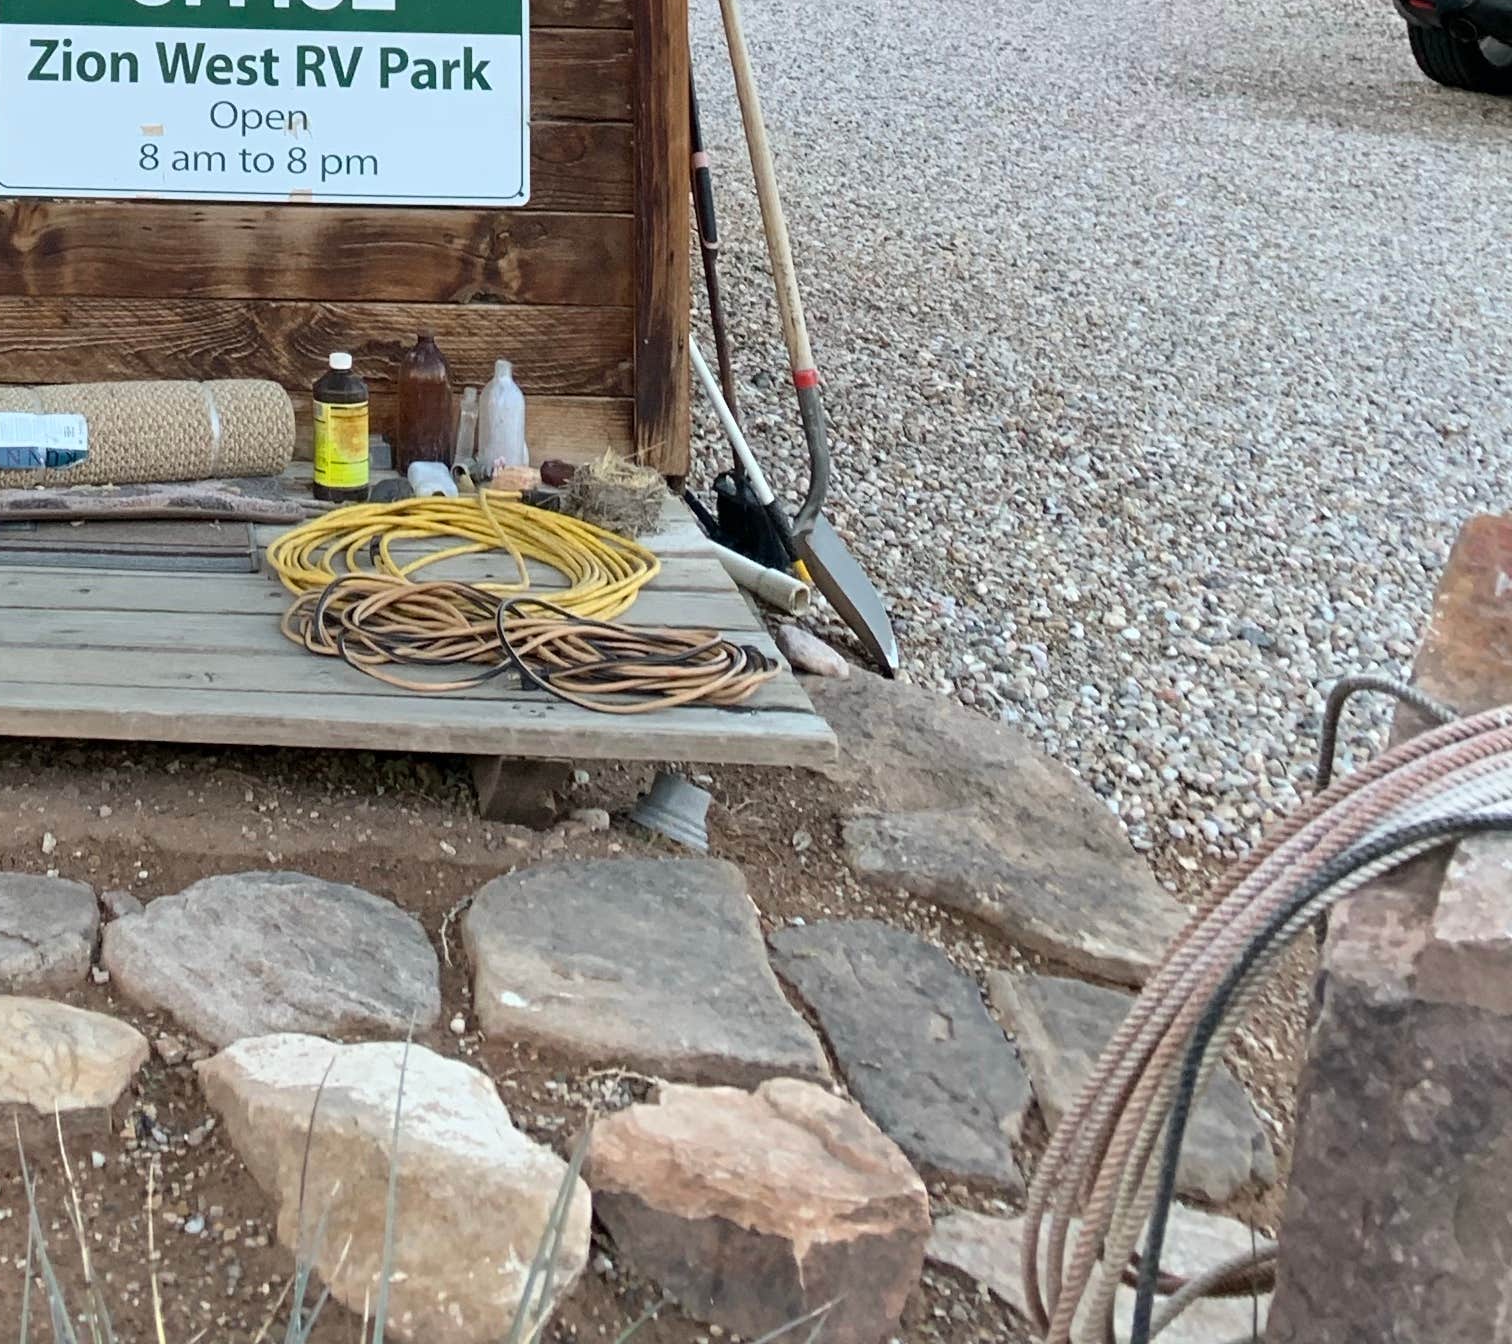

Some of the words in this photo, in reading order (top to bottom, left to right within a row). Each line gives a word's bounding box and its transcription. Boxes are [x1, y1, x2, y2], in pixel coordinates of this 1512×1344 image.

[27, 38, 139, 83] Zion
[155, 41, 280, 87] West
[295, 45, 363, 88] RV
[379, 47, 493, 91] Park
[209, 100, 309, 137] Open
[138, 143, 160, 173] 8
[170, 149, 227, 173] am
[238, 149, 276, 174] to
[286, 147, 308, 175] 8
[320, 151, 379, 183] pm
